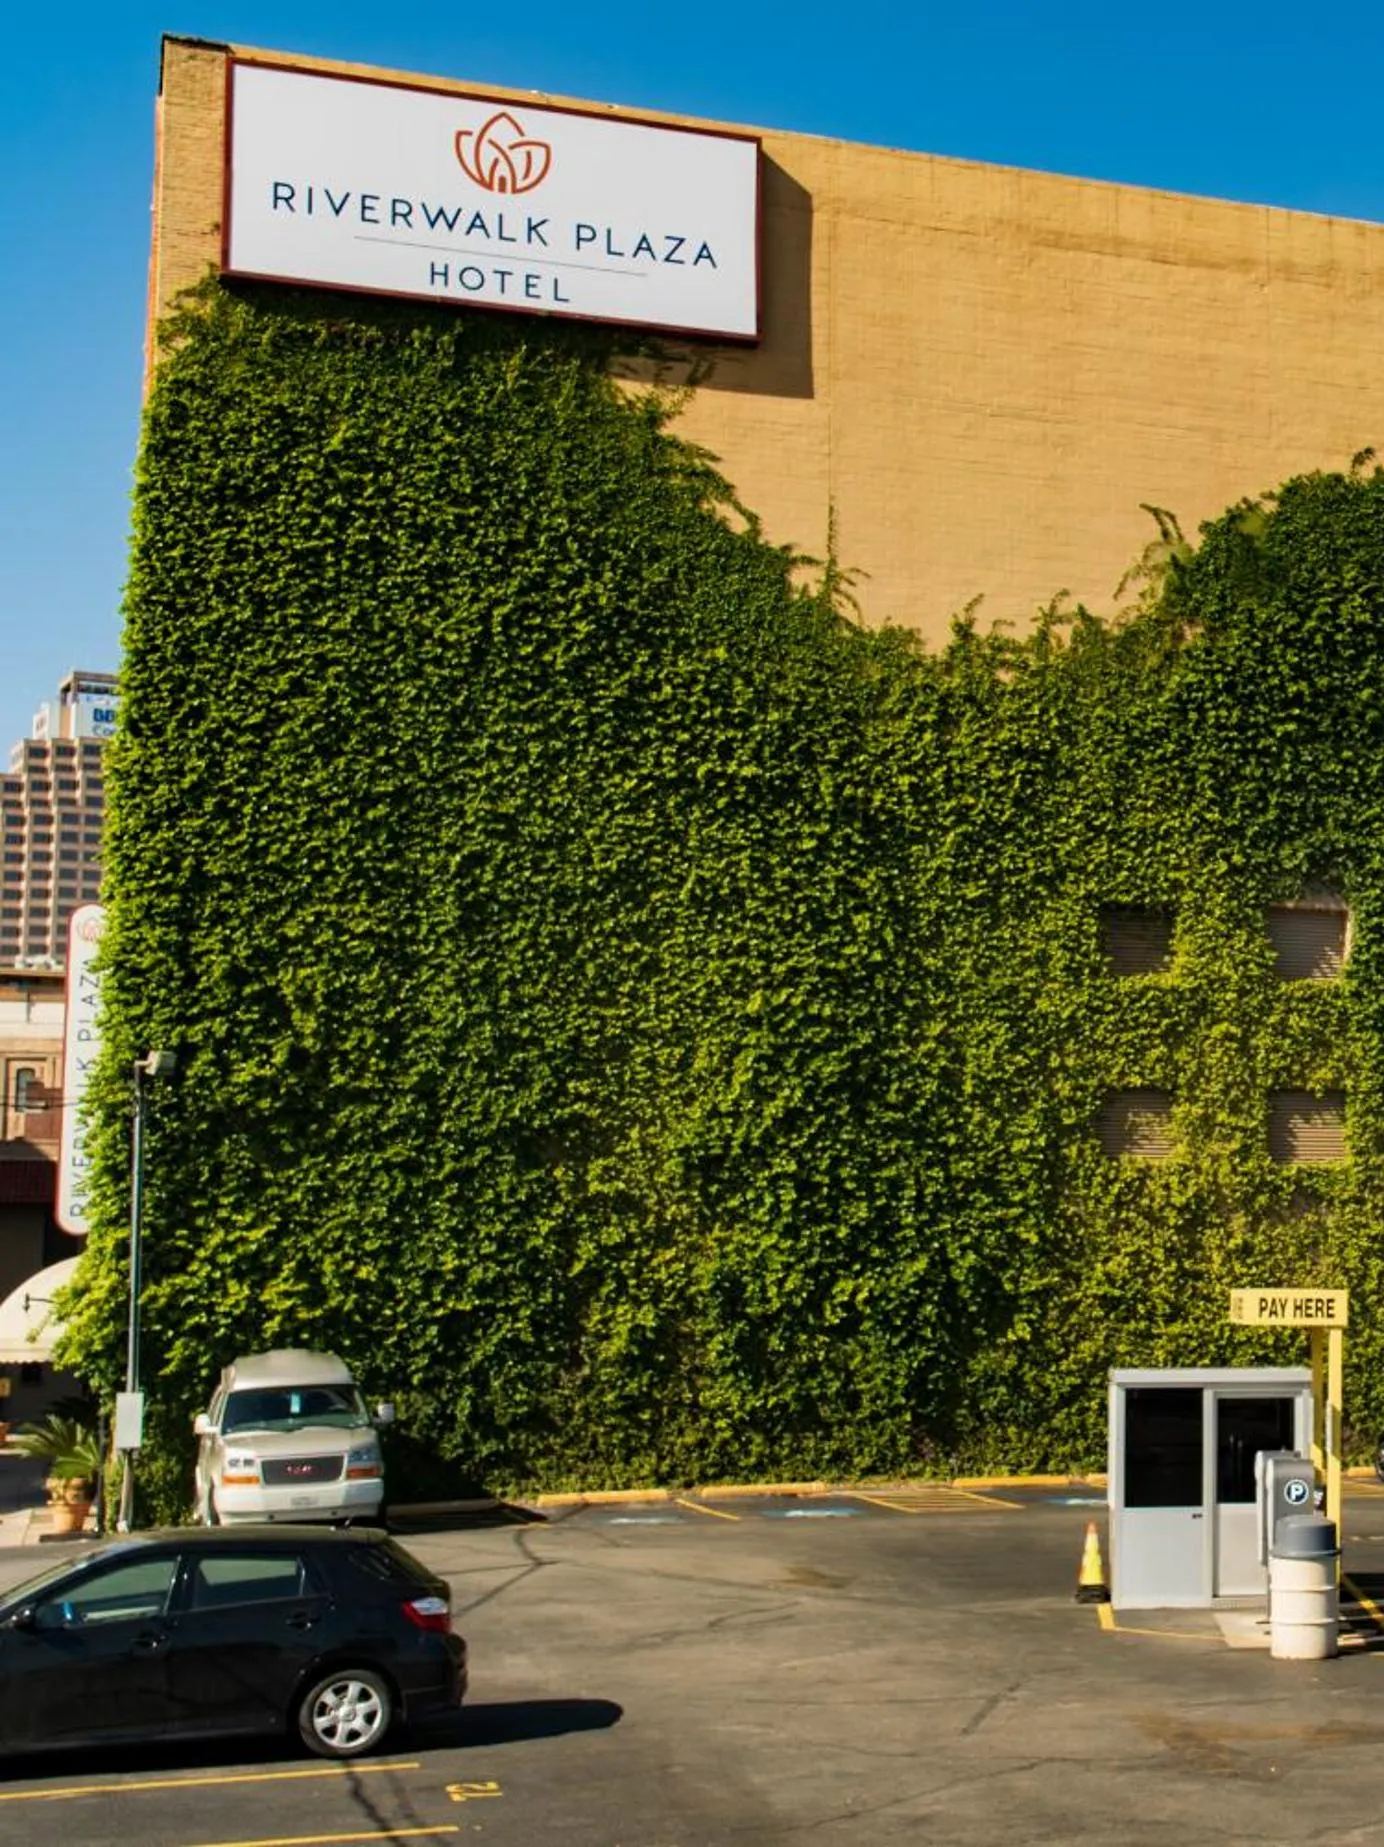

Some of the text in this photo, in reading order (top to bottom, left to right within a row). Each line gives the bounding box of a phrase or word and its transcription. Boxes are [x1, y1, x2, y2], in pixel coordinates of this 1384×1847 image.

[272, 182, 718, 269] RIVERWALK PLAZA
[430, 262, 570, 303] HOTEL
[1258, 1297, 1288, 1319] PAY
[1293, 1298, 1335, 1319] HERE
[1291, 1484, 1304, 1501] P
